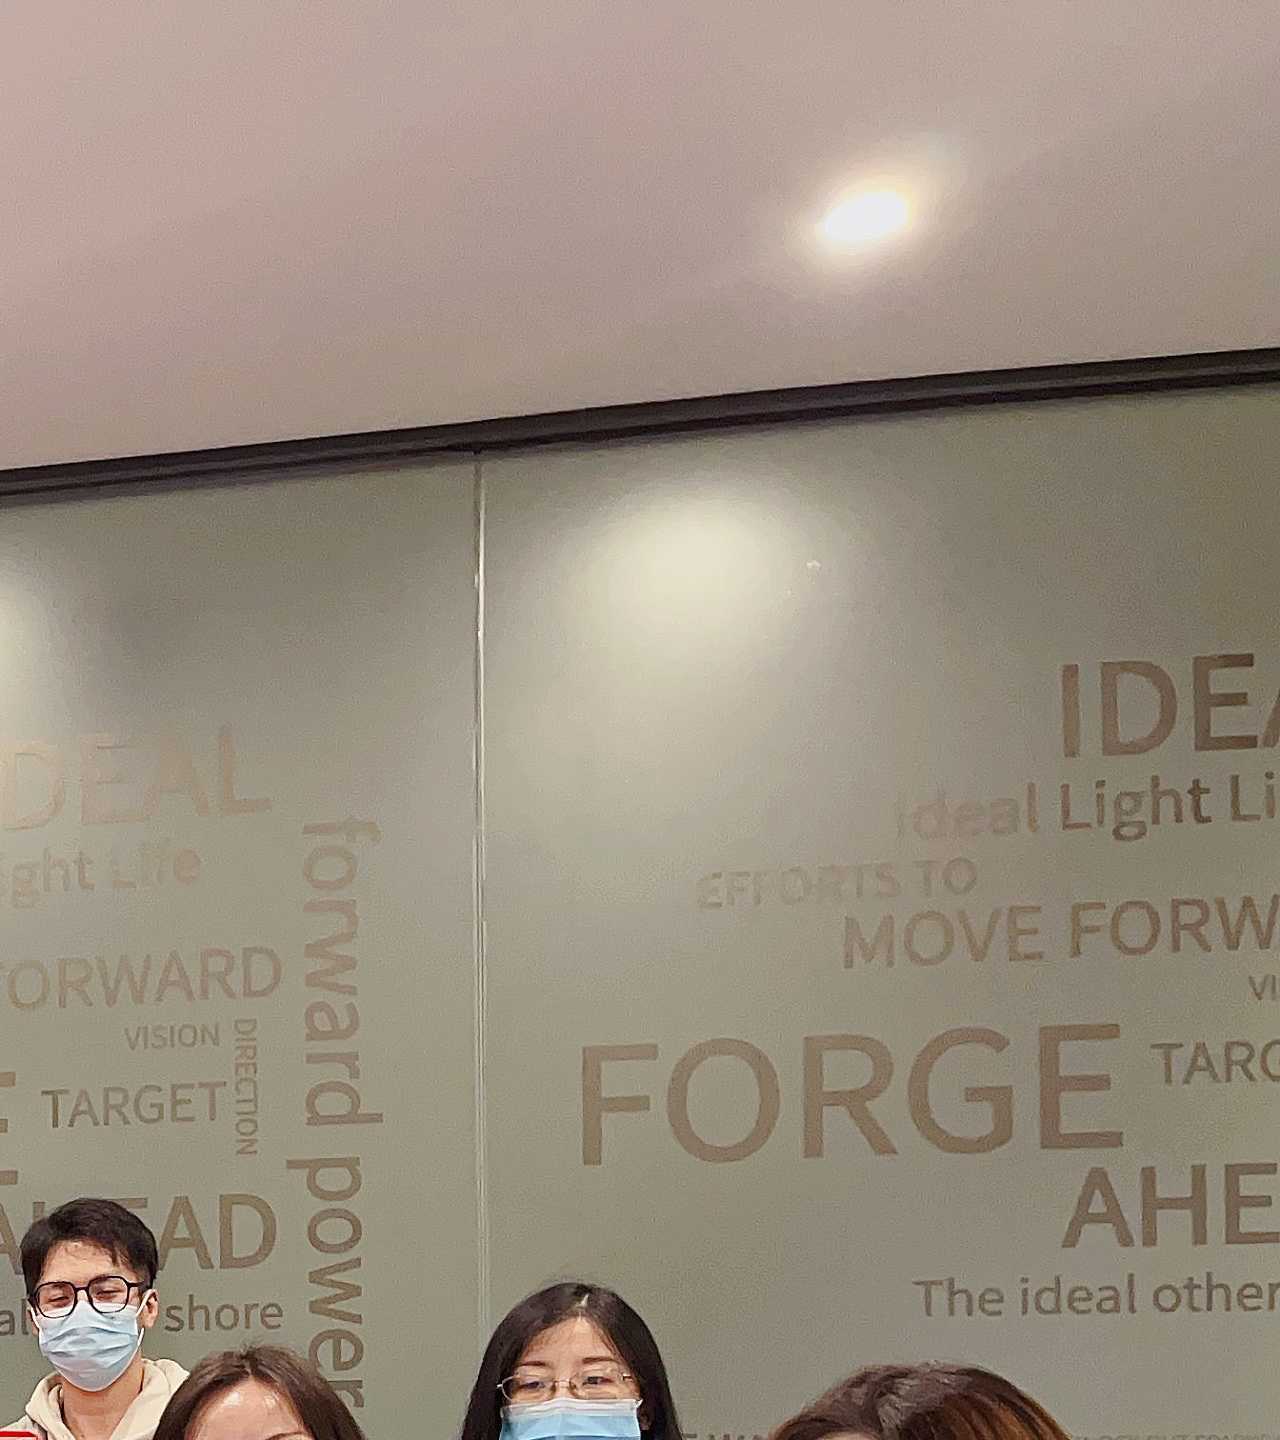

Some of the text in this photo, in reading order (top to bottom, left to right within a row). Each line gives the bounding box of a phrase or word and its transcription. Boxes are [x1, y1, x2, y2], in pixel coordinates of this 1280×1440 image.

[1060, 653, 1280, 759] IDE
[897, 772, 1280, 841] Ideal Light Li
[112, 834, 203, 888] Life
[697, 857, 978, 911] EFFORTS TO
[843, 892, 1280, 970] MOVE FORW
[125, 1021, 220, 1052] VISION
[41, 1080, 228, 1131] TARGET
[234, 1018, 258, 1156] DIRECTION
[286, 816, 383, 1408] forward power
[581, 1023, 1124, 1166] FORGE
[1062, 1163, 1280, 1249] AHE
[164, 1296, 285, 1335] shore
[913, 1277, 1004, 1319] The
[1019, 1275, 1137, 1316] ideal
